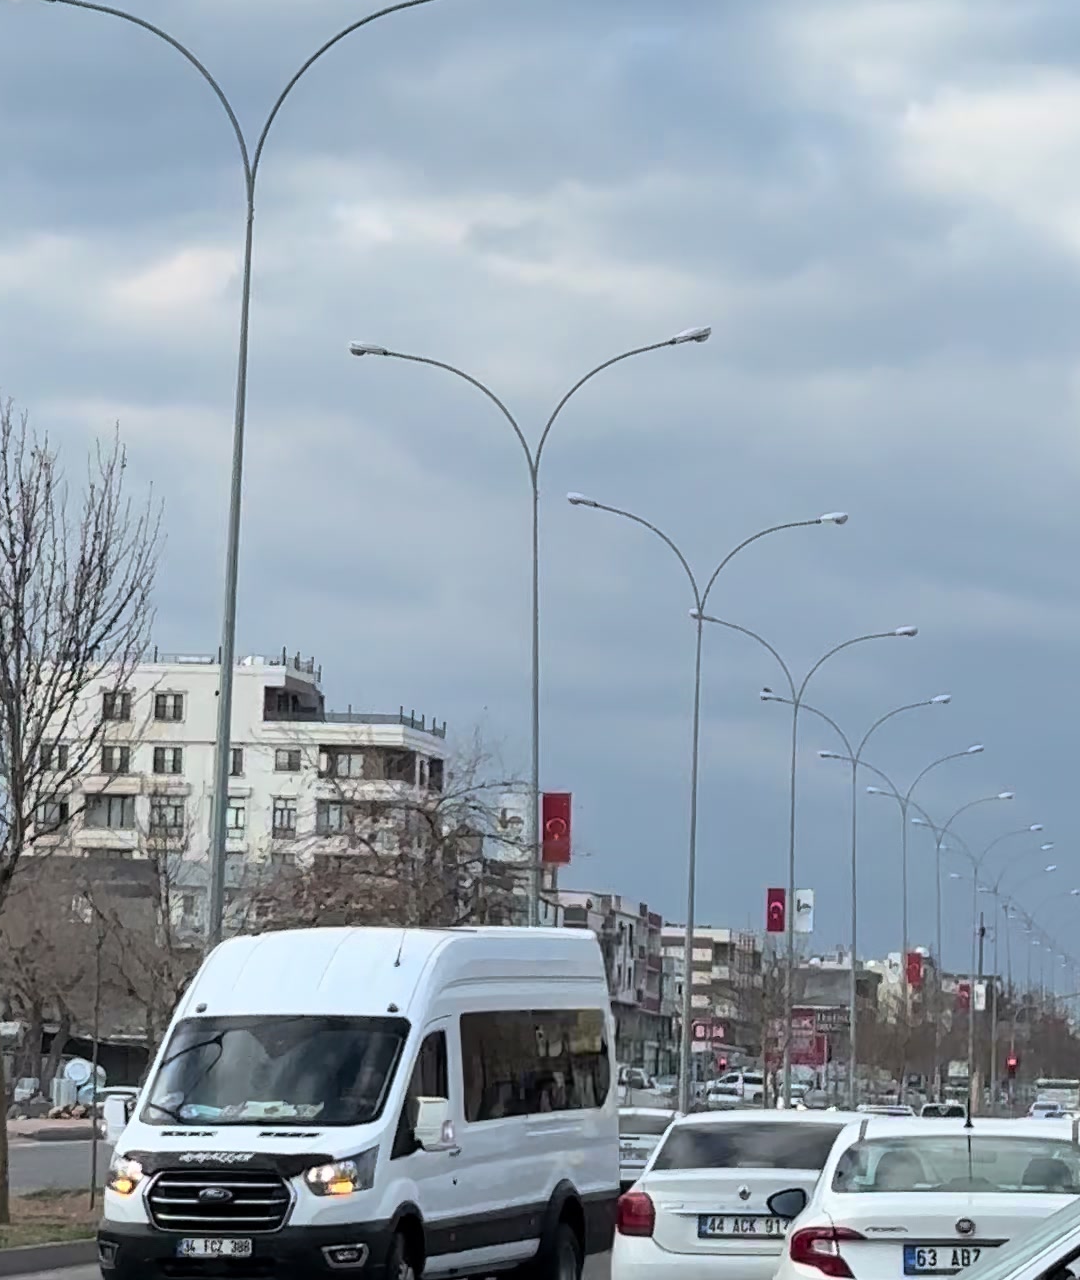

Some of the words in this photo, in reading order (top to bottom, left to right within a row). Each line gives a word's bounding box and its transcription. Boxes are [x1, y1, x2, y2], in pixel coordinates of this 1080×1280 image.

[707, 1217, 725, 1233] 44
[732, 1218, 757, 1233] ACK
[916, 1248, 937, 1267] 63
